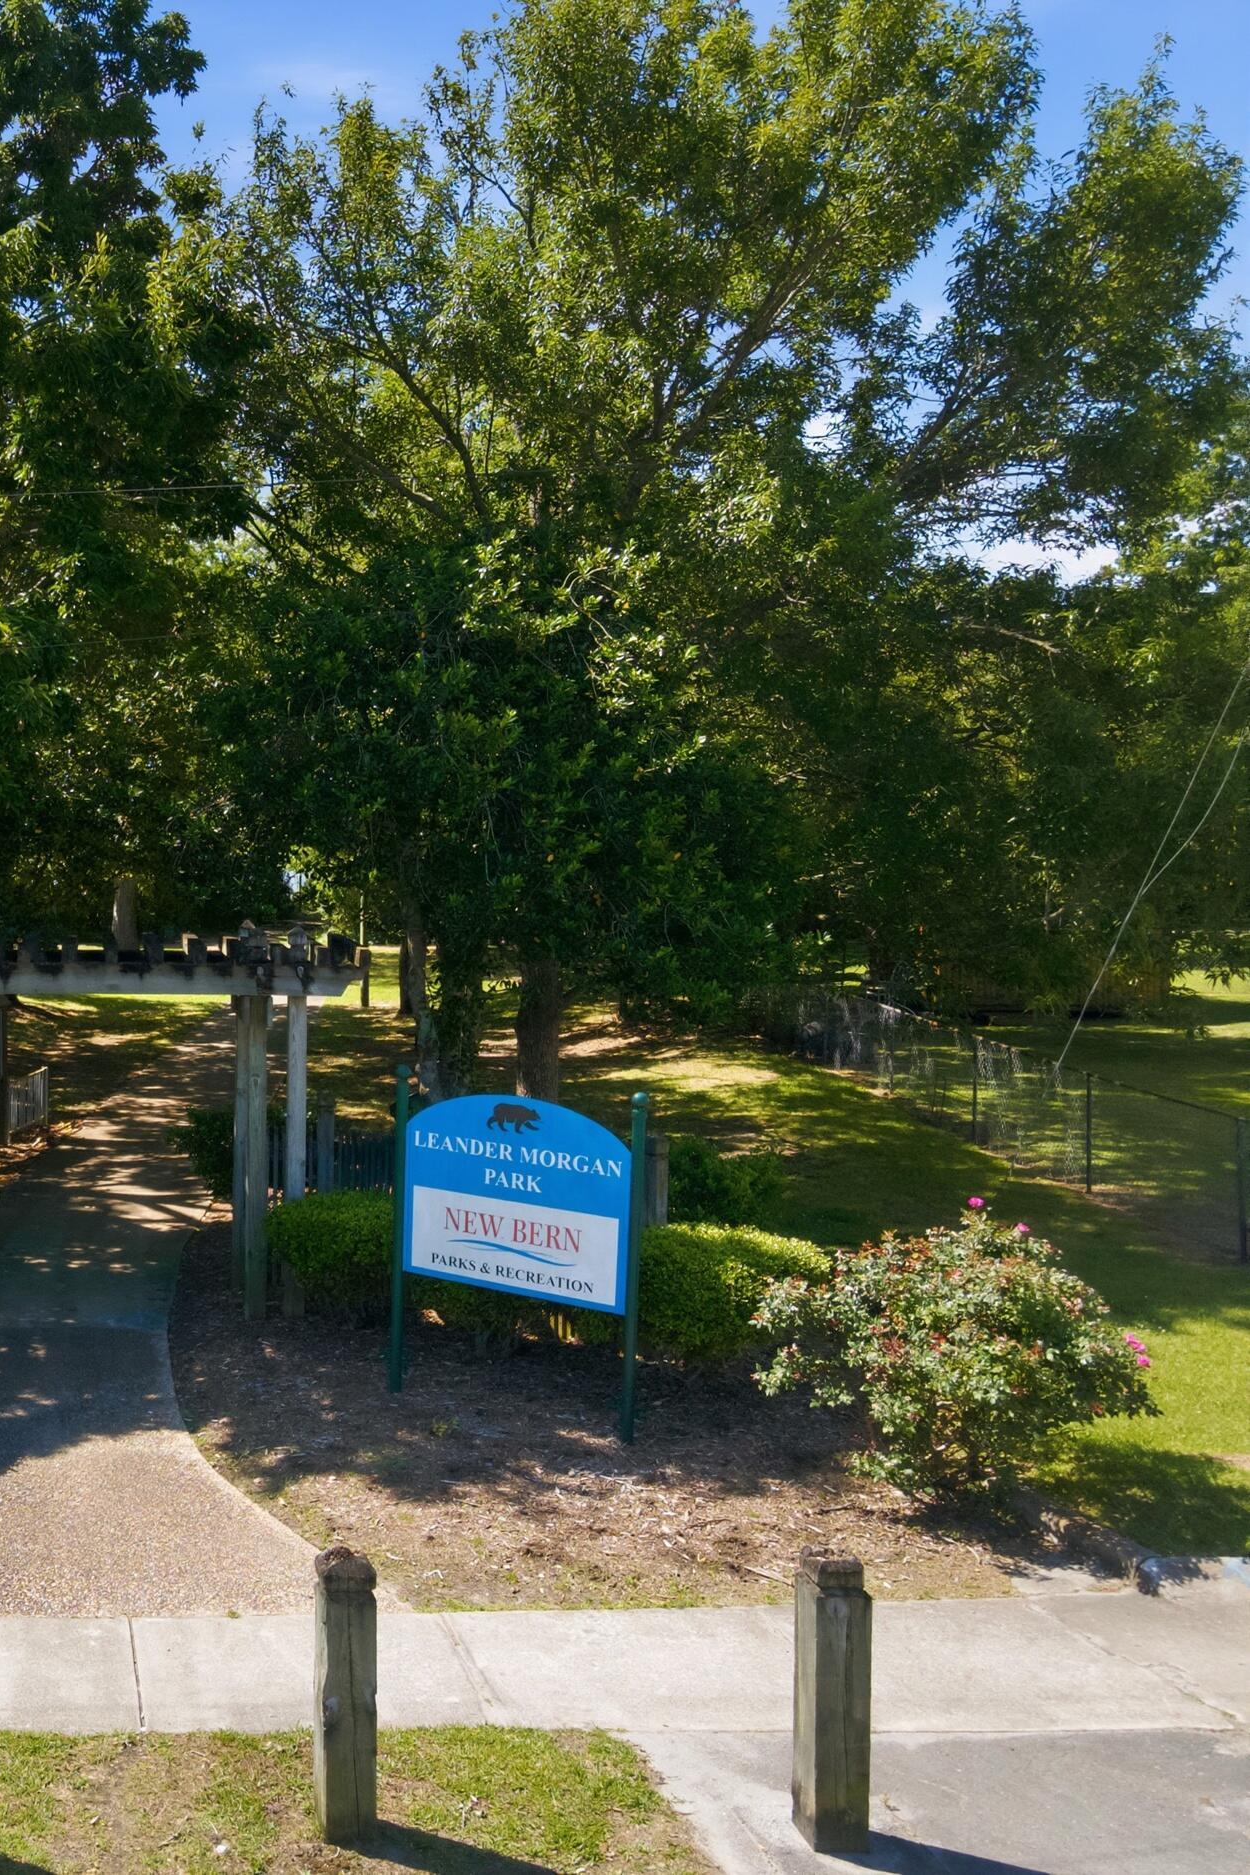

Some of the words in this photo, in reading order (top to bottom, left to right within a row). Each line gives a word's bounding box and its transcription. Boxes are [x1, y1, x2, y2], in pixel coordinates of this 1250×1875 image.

[414, 1130, 513, 1162] LEANDER
[520, 1147, 622, 1178] MORGAN
[484, 1168, 542, 1193] PARK
[445, 1207, 504, 1238] NEW
[513, 1218, 582, 1253] BERN
[431, 1252, 476, 1272] PARKS
[480, 1262, 491, 1274] &
[495, 1264, 595, 1294] RECREATION
